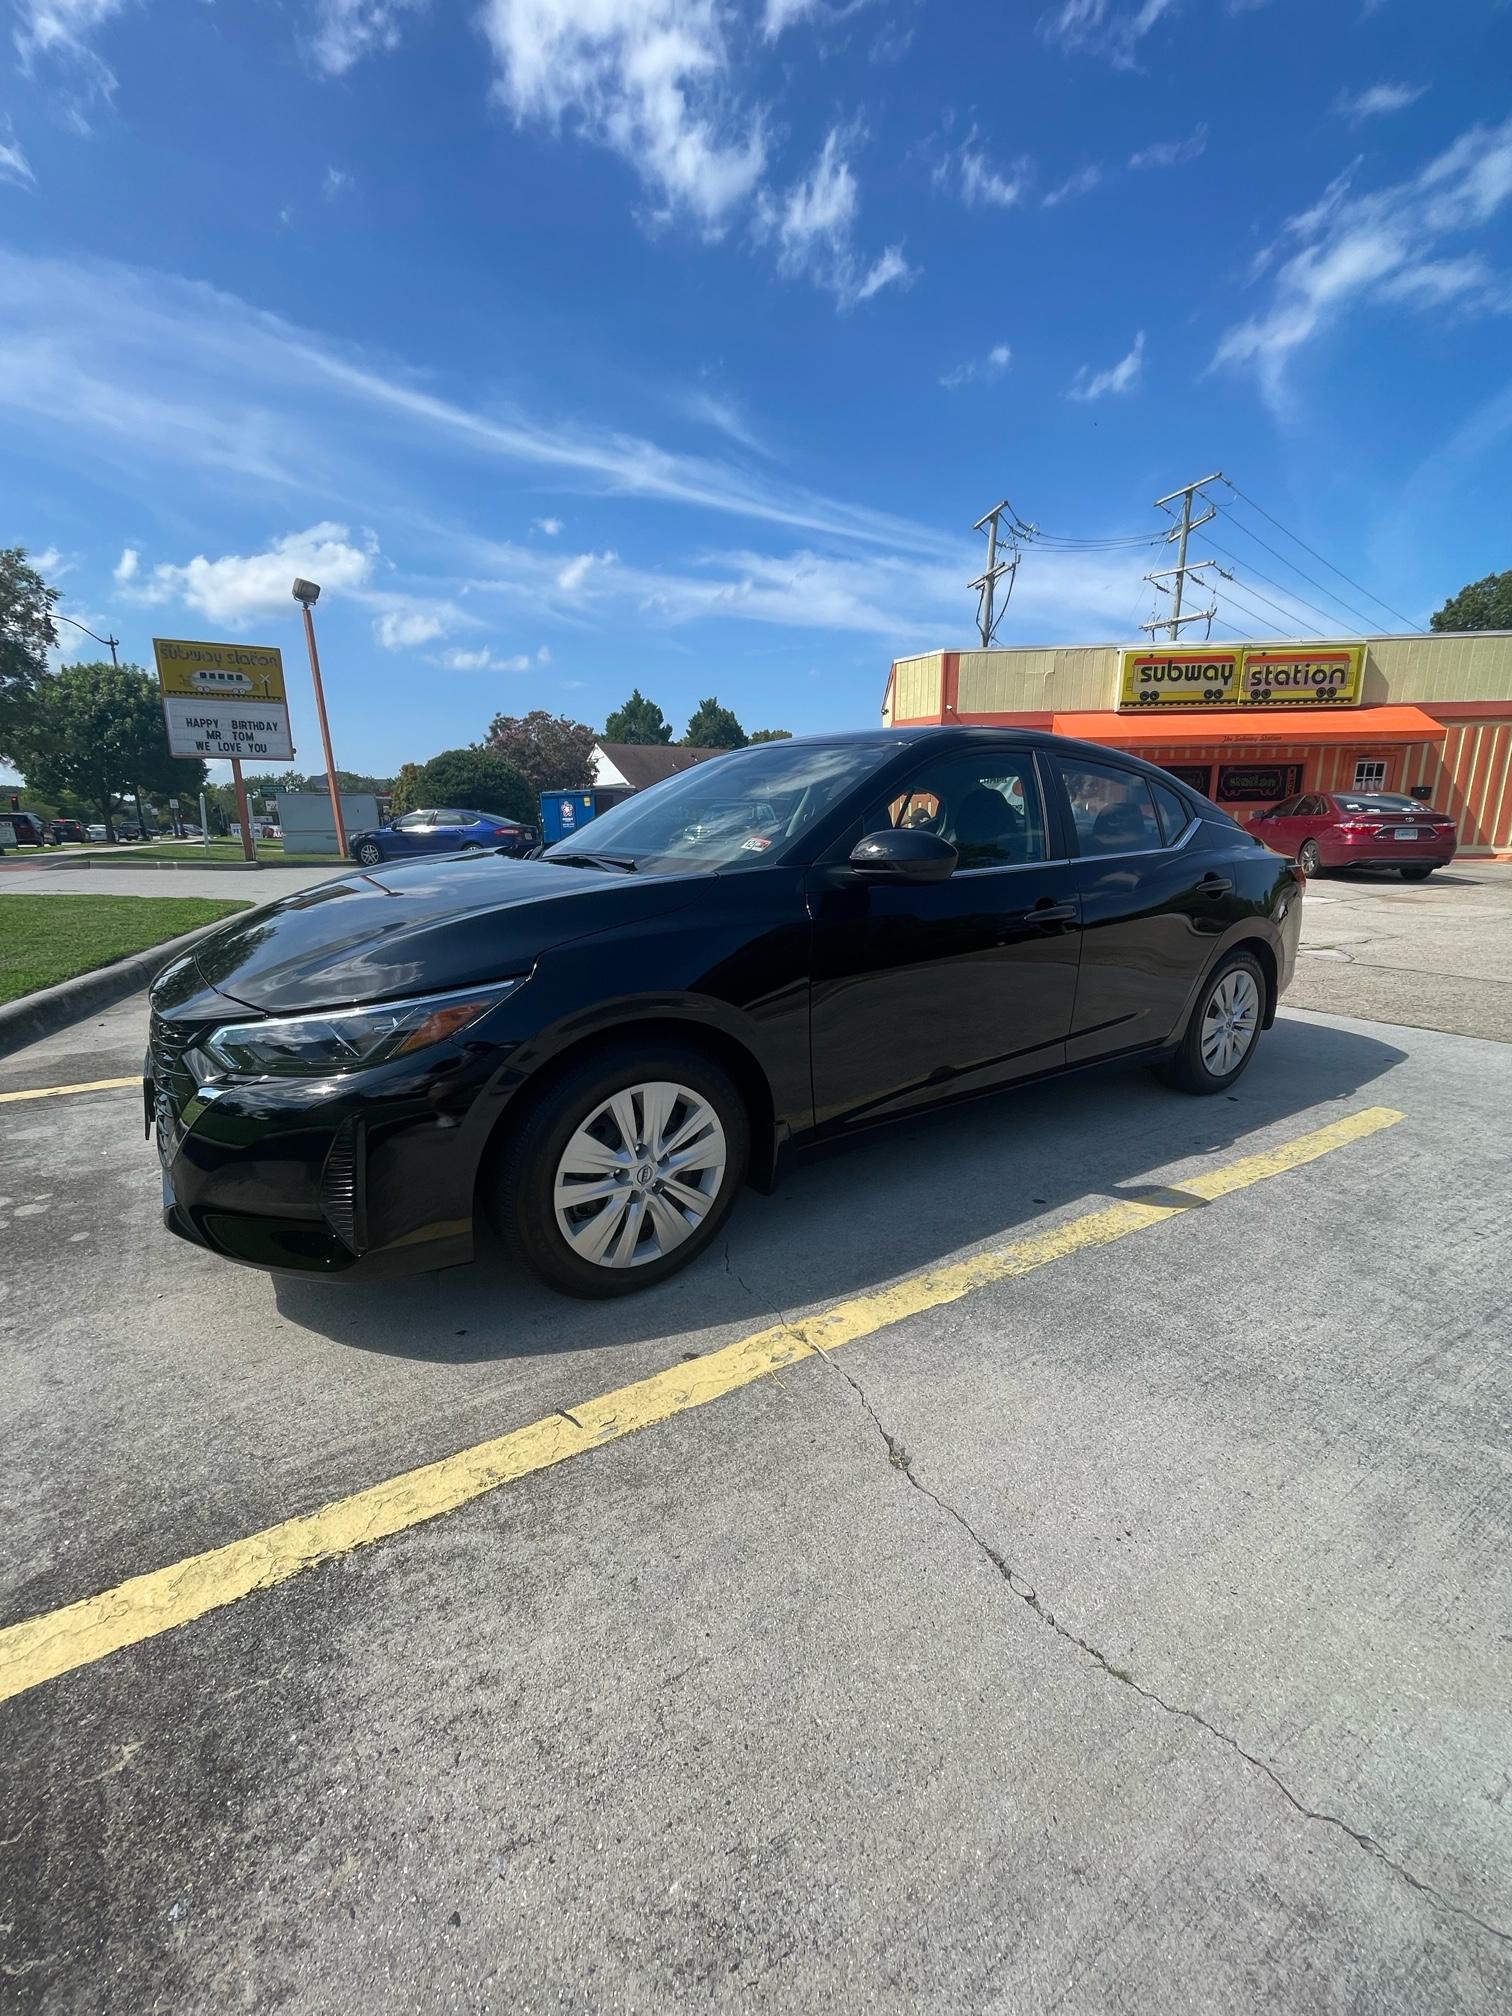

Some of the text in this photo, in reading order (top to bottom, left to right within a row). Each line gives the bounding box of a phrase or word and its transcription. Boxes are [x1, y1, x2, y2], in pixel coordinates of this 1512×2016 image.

[160, 645, 222, 666] subway
[1140, 660, 1346, 687] subway station
[186, 718, 278, 731] HAPPY BIRTHDAY
[206, 730, 255, 741] MR TOM
[195, 741, 267, 753] WE LOVE YOU
